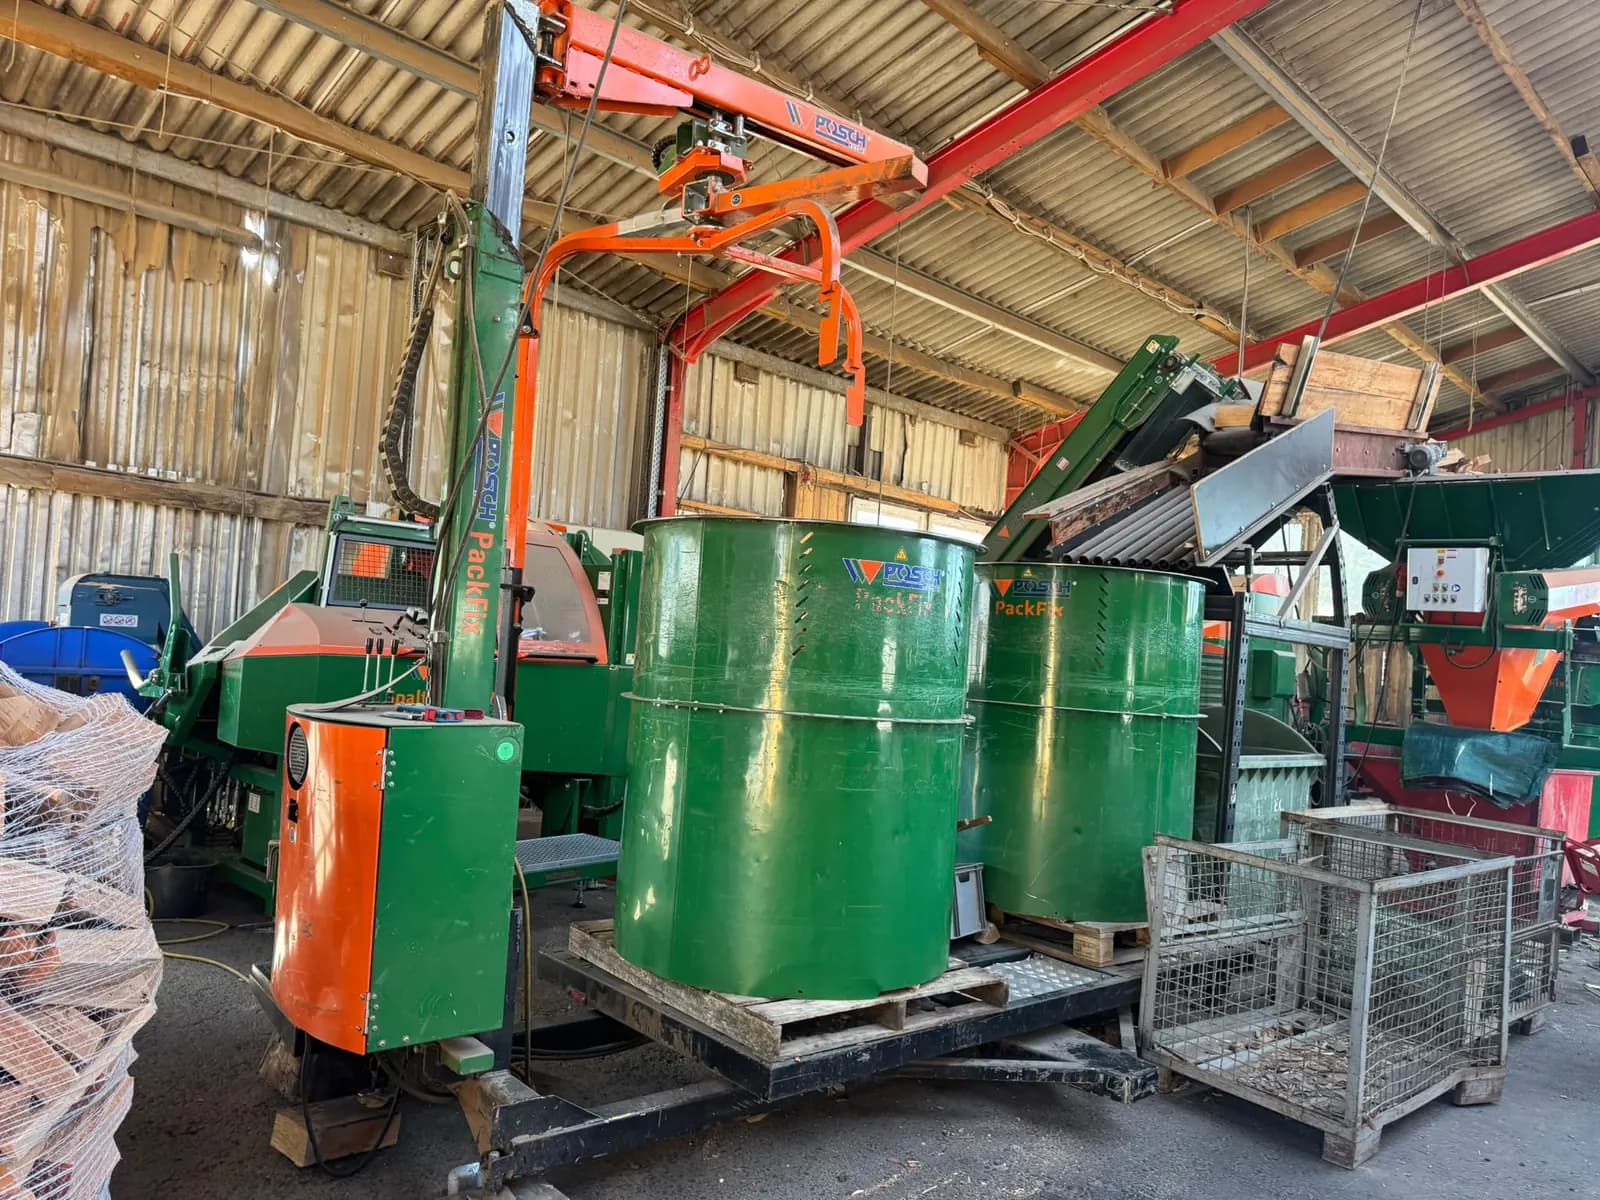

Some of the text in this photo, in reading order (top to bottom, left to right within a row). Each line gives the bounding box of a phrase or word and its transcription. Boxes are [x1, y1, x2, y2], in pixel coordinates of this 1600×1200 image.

[815, 115, 867, 149] POSCH
[463, 531, 494, 636] PackFix
[883, 562, 942, 587] POSCH
